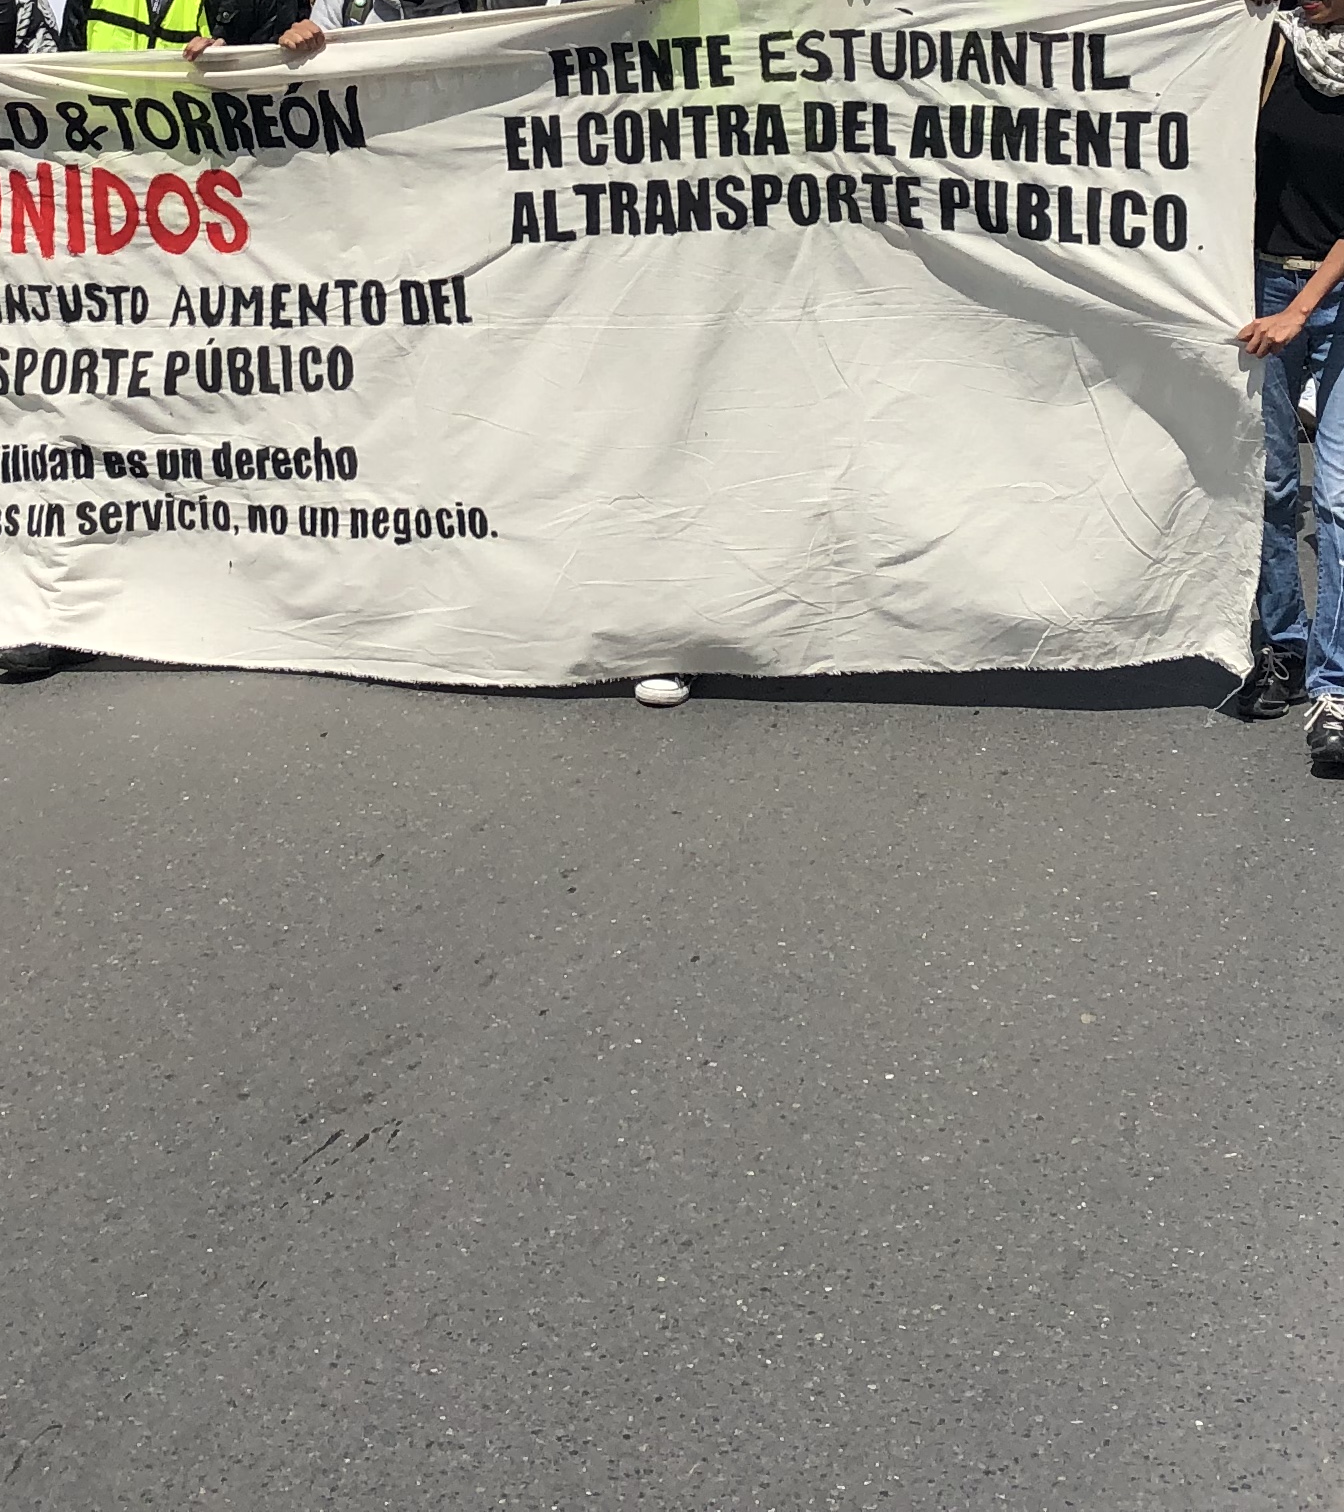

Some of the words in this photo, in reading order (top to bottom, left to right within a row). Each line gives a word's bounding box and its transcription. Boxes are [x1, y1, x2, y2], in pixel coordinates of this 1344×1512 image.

[548, 34, 735, 99] FRENTE
[758, 28, 1131, 90] ESTUDIANTIL
[55, 100, 110, 152] &
[87, 82, 368, 158] TORREÓN
[503, 107, 563, 172] EN
[577, 102, 790, 169] CONTRA
[803, 100, 897, 157] DEL
[909, 104, 1189, 172] AUMENTO
[510, 190, 577, 245] AL
[574, 172, 924, 239] TRANSPORTE
[169, 277, 388, 327] AUMENTO
[399, 274, 474, 327] DEL
[163, 337, 355, 397] PÚBLICO
[102, 448, 150, 481] es
[156, 447, 204, 480] un
[211, 436, 359, 484] derecho
[26, 501, 66, 539] un
[76, 493, 240, 537] servicio,
[247, 504, 288, 535] no
[298, 508, 340, 538] un
[350, 504, 500, 545] negocio.
